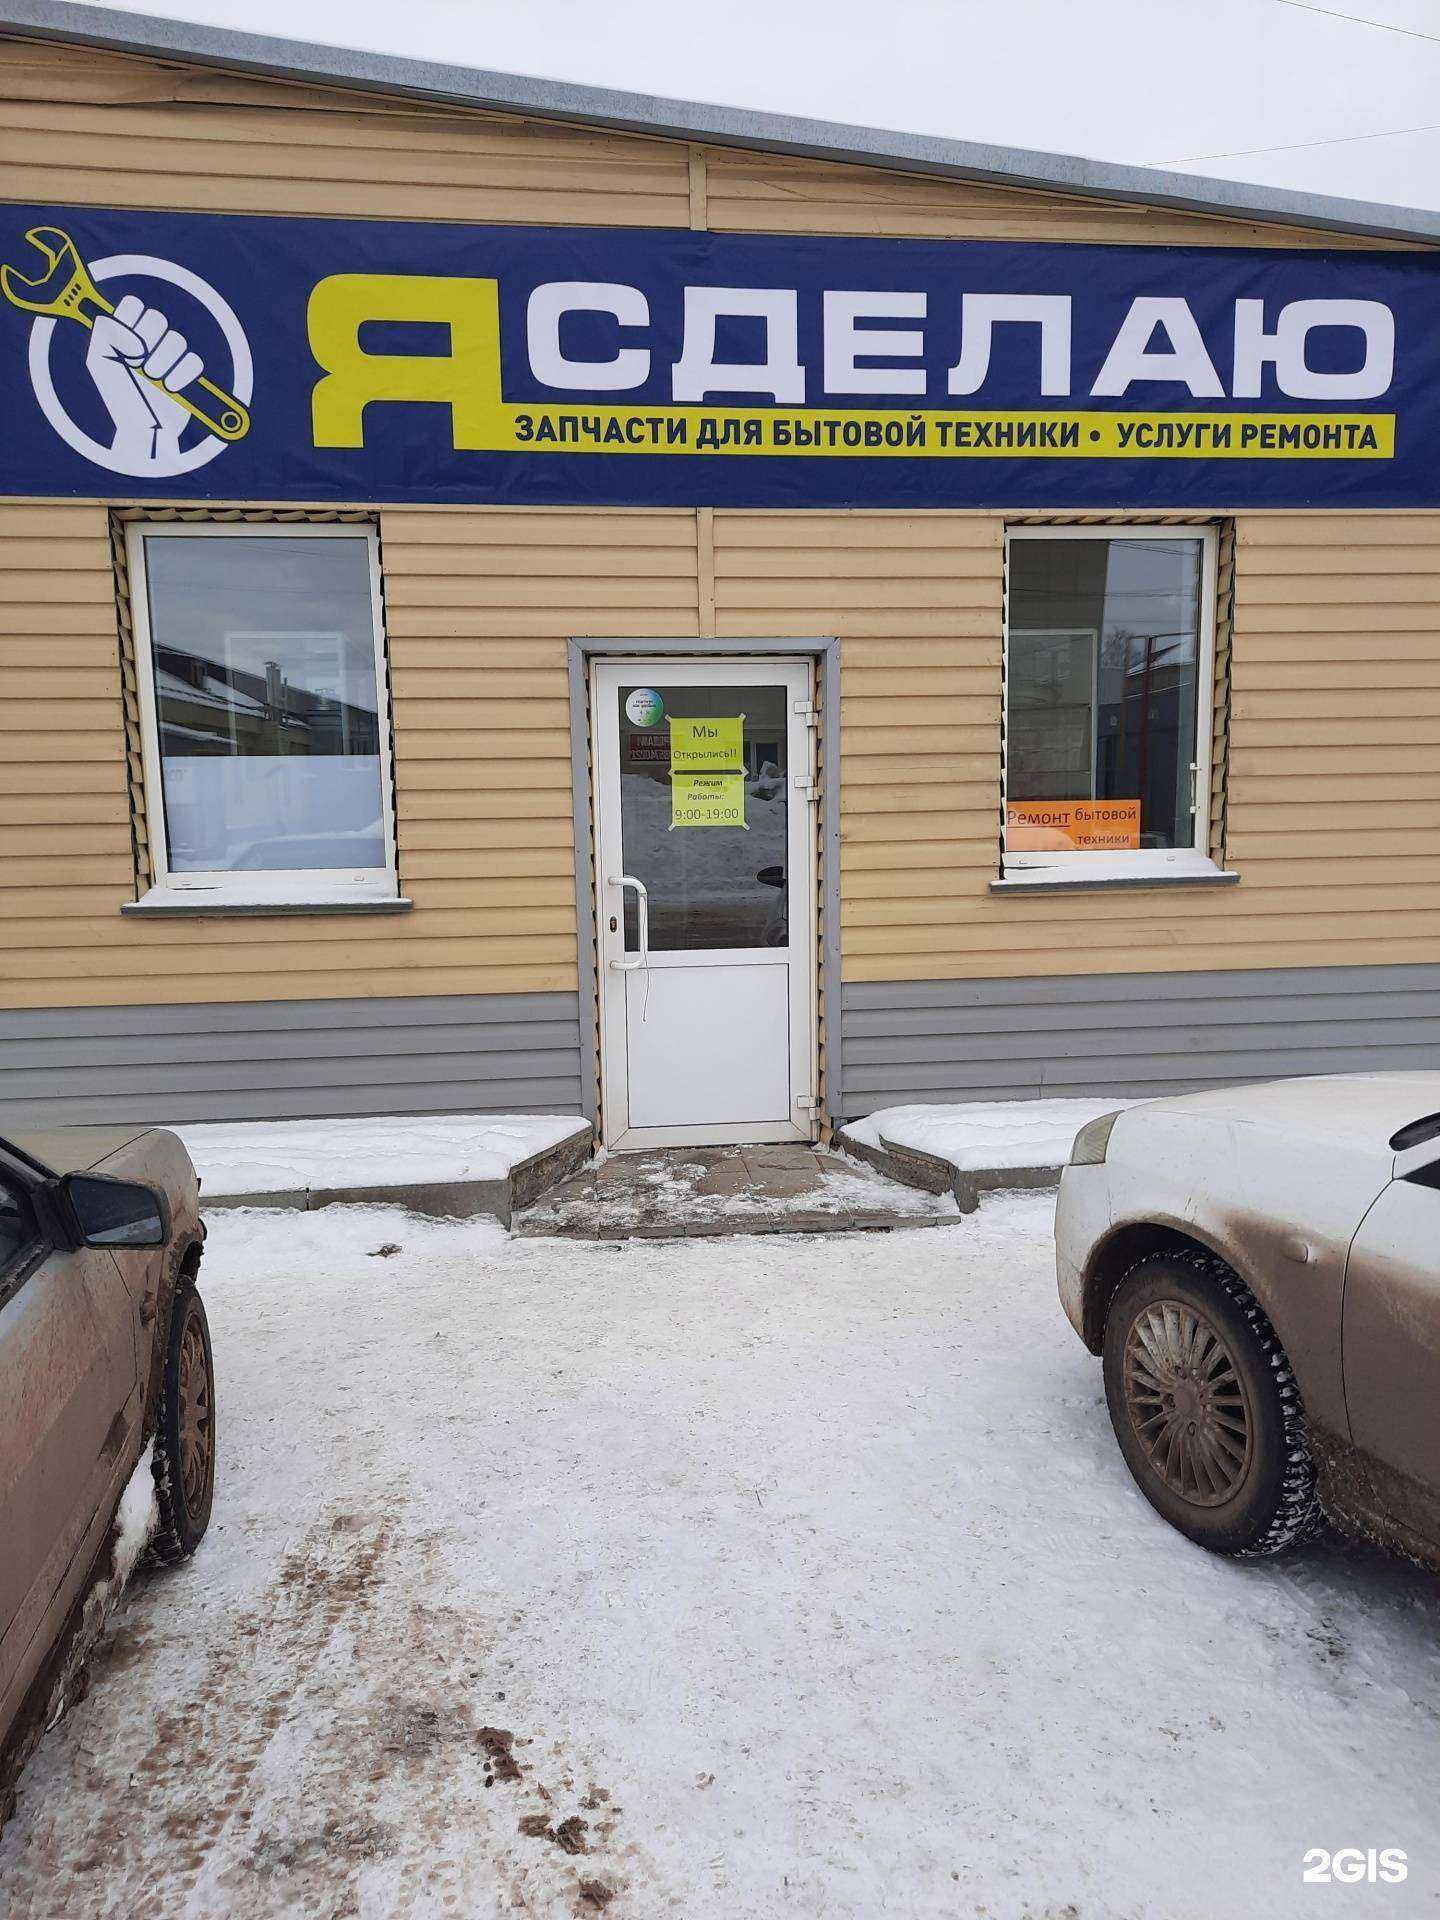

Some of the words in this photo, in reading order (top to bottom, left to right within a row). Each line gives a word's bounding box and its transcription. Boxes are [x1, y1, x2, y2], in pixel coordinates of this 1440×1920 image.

[306, 273, 502, 450] Я
[526, 281, 1396, 404] СДЕЛАЮ
[514, 414, 687, 445] ЗАПЧАСТИ
[696, 417, 762, 450] ДЛЯ
[772, 415, 926, 447] БЫТОВОЙ
[936, 421, 1080, 449] ТЕХНИКИ
[1117, 422, 1228, 449] УСЛУГИ
[1240, 423, 1378, 450] РЕМОНТА
[692, 726, 717, 738] Мы
[673, 749, 737, 760] Открылись!!
[693, 779, 723, 787] Режим
[687, 793, 725, 801] Работы:
[675, 808, 739, 820] 9:00-19:00
[1007, 810, 1070, 825] Ремонт
[1075, 807, 1136, 821] бытовой
[1077, 833, 1130, 846] техники
